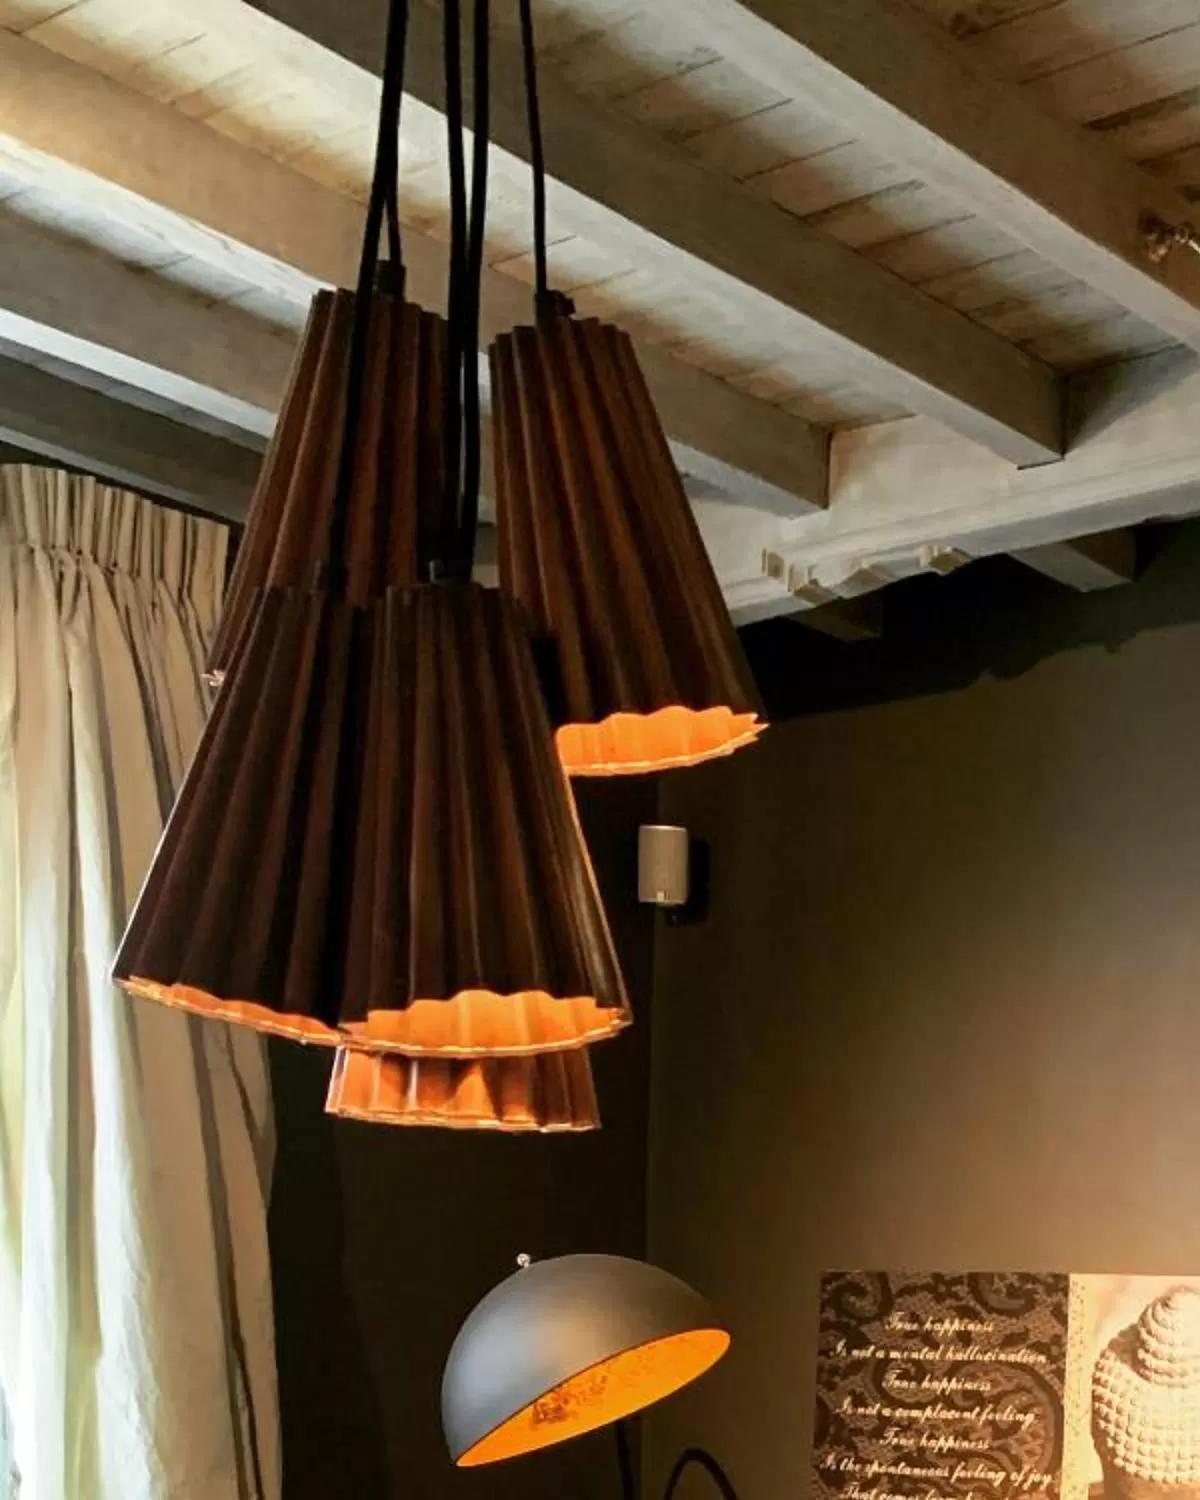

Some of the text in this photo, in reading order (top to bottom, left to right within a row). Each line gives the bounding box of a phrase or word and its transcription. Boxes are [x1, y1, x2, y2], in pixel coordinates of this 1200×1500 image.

[885, 1312, 994, 1337] True happiness
[852, 1345, 876, 1359] not
[876, 1350, 885, 1359] a
[889, 1344, 944, 1360] mental
[881, 1369, 991, 1394] True happiness
[856, 1403, 880, 1416] not
[882, 1408, 891, 1417] a
[895, 1403, 979, 1424] complacent
[879, 1427, 989, 1453] True happiness
[839, 1458, 861, 1472] the
[865, 1461, 949, 1477] spontaneous
[950, 1461, 1006, 1487] feeling
[1009, 1466, 1026, 1487] of
[1023, 1470, 1052, 1490] joy
[838, 1482, 875, 1499] That
